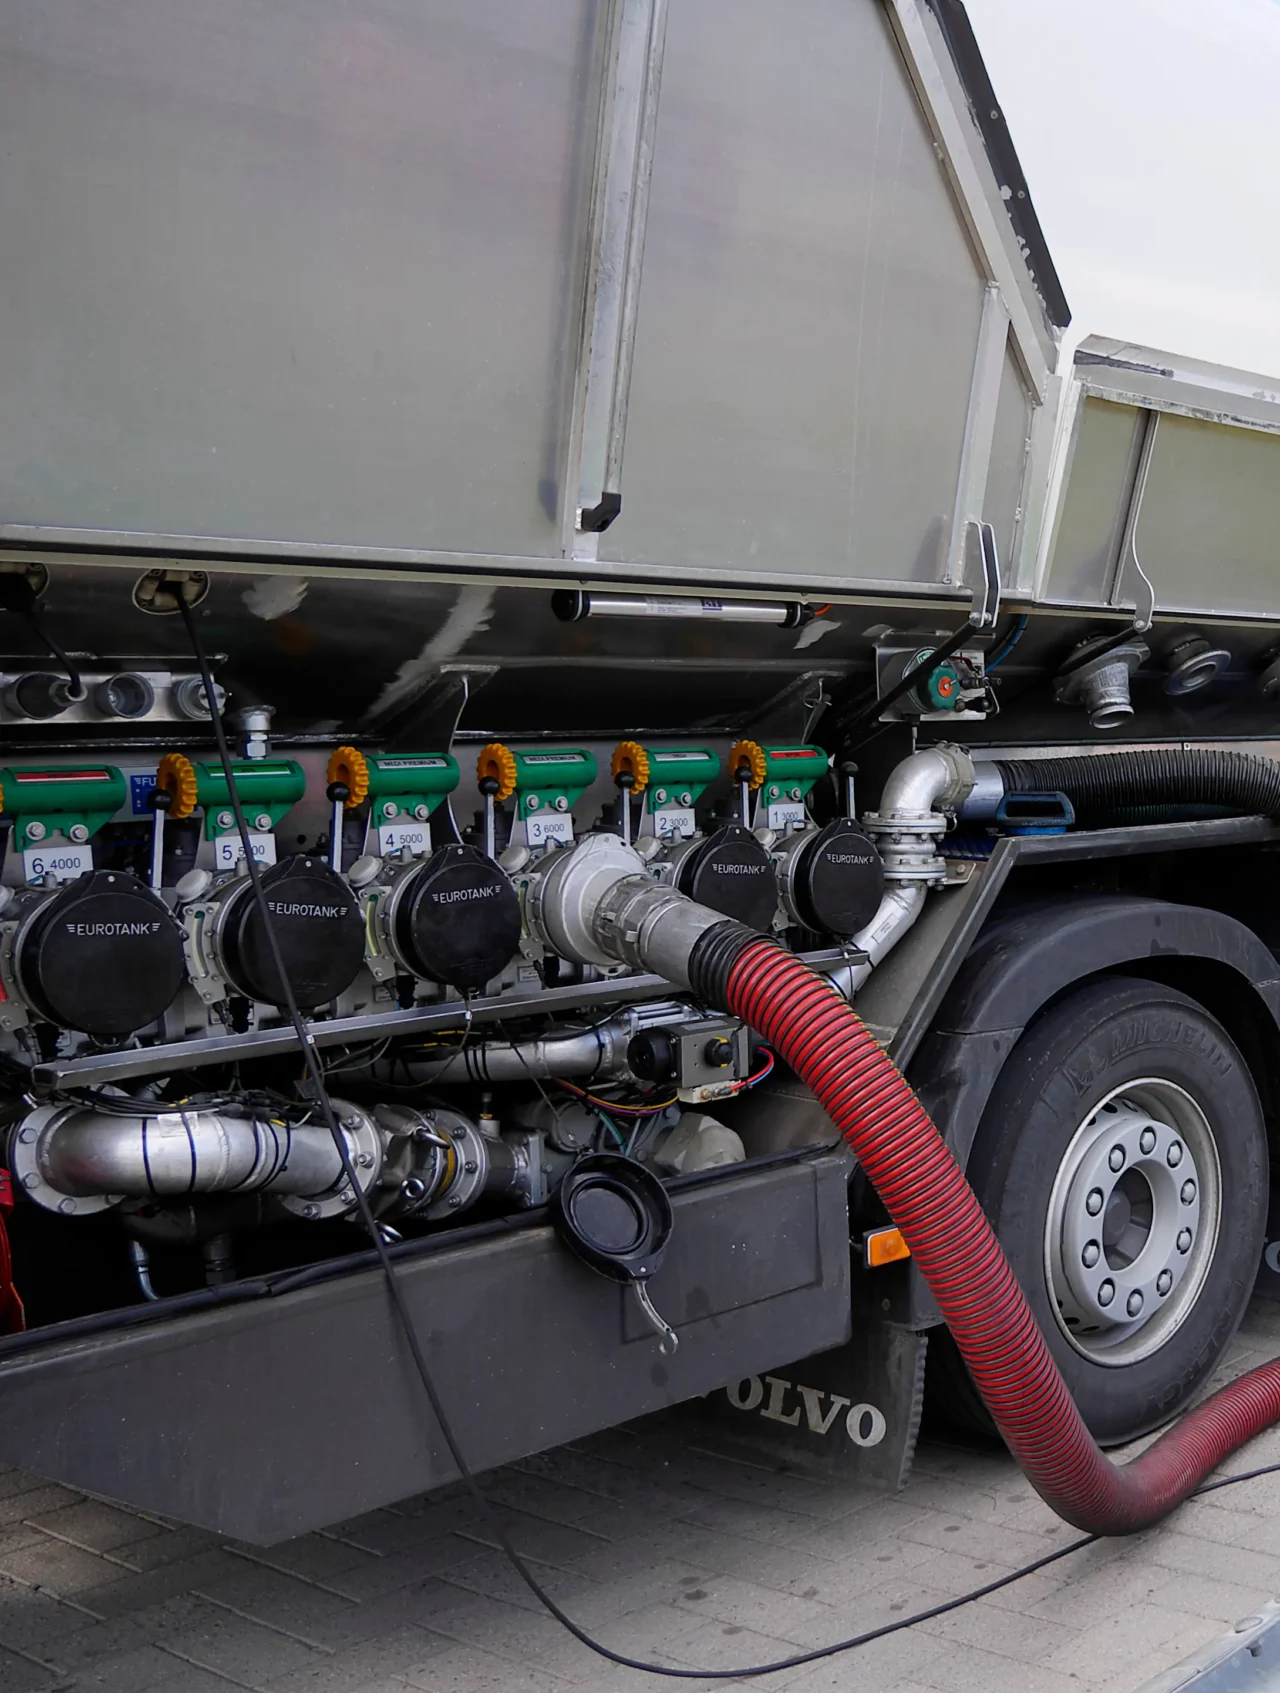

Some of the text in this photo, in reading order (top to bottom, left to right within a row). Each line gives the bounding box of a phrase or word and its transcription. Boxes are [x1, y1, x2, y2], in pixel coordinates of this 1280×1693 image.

[142, 777, 157, 787] FU
[660, 817, 689, 830] 2 3000
[773, 811, 799, 823] 1 3000
[533, 823, 565, 838] 3 6000
[386, 833, 423, 847] 4 5000
[222, 844, 265, 860] 5 500
[831, 853, 869, 865] EUROTANK
[32, 858, 81, 874] 6 4000
[718, 863, 760, 875] EUROTANK
[440, 886, 494, 904] EUROTANK
[276, 902, 339, 918] EUROTANK
[77, 923, 150, 936] EUROTANK
[1111, 1018, 1234, 1079] MICHELIN
[704, 1374, 886, 1447] OLVO
